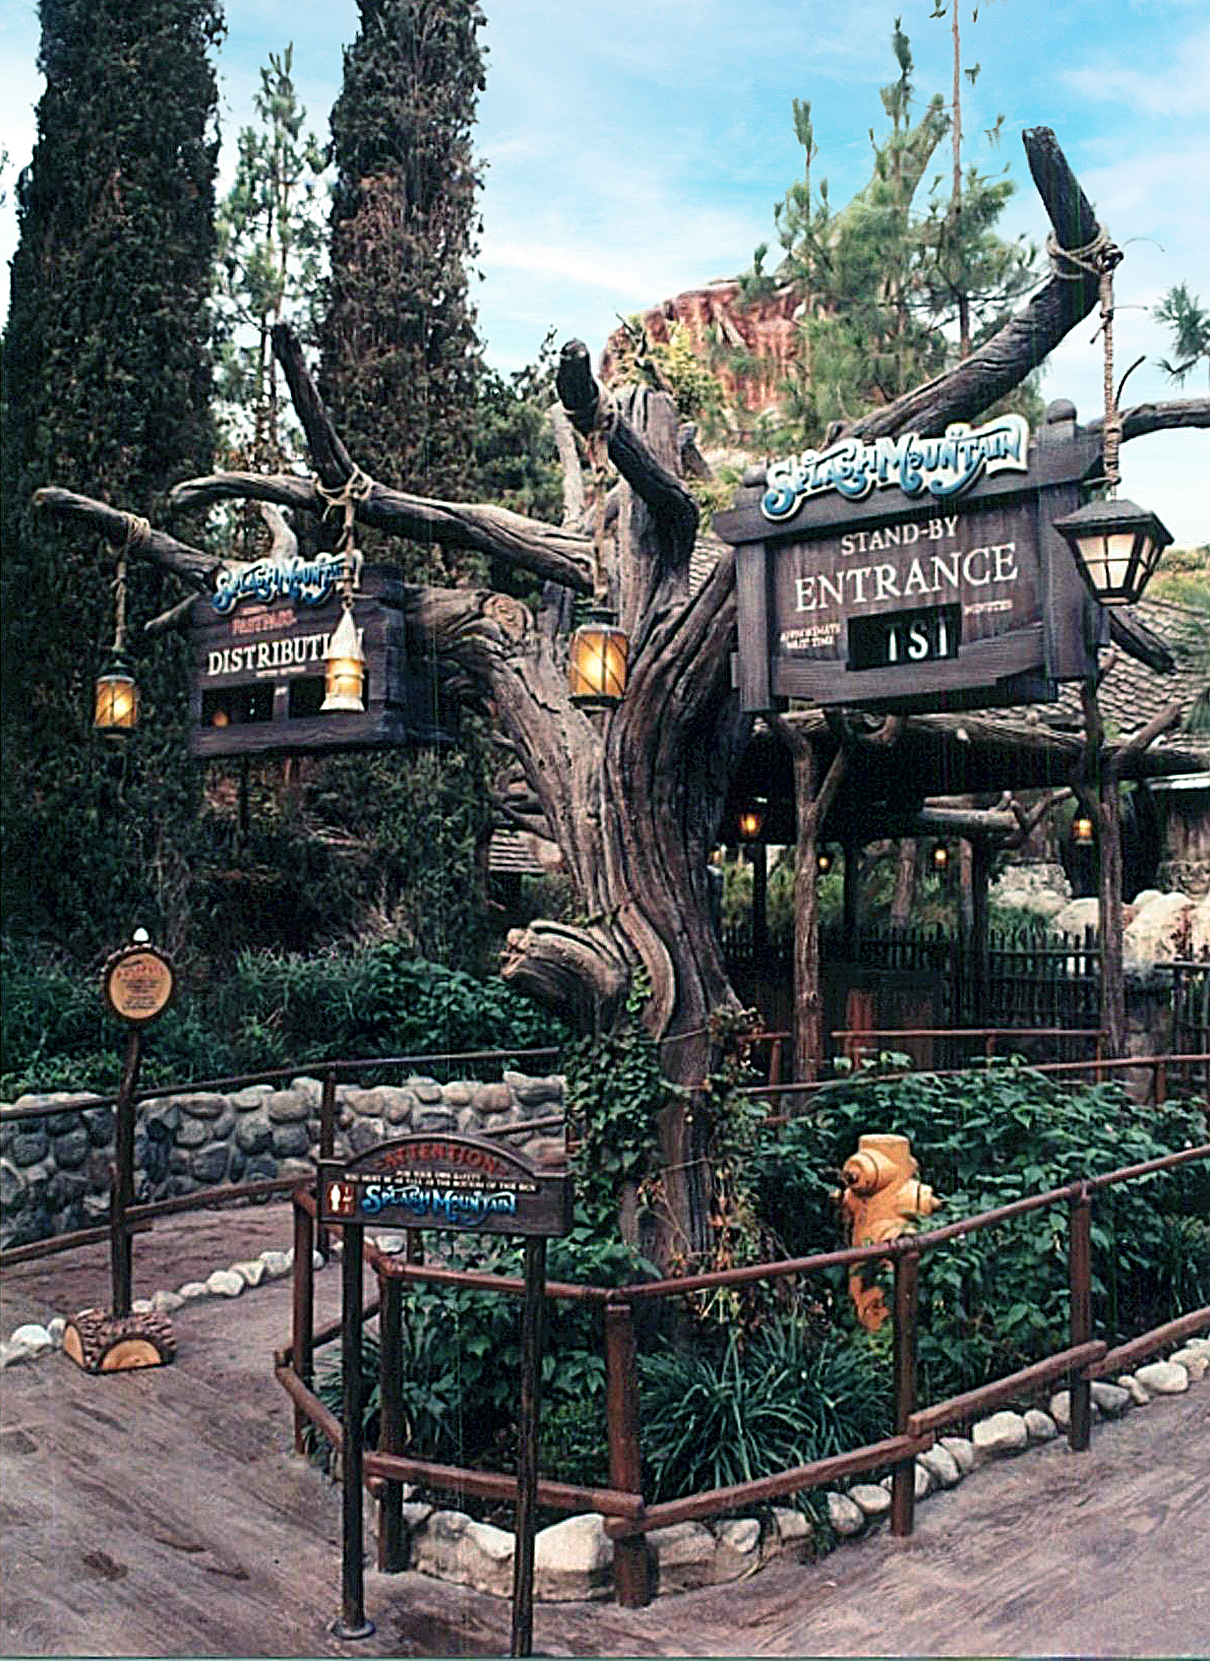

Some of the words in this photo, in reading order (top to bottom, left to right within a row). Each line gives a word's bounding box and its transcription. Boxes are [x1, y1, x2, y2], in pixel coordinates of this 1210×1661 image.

[841, 514, 958, 556] STAND-BY
[794, 542, 1018, 613] ENTRANCE
[207, 627, 365, 677] DISTRIBUTI
[362, 1184, 430, 1216] SPLASH
[432, 1188, 517, 1227] MOUNTAIN
